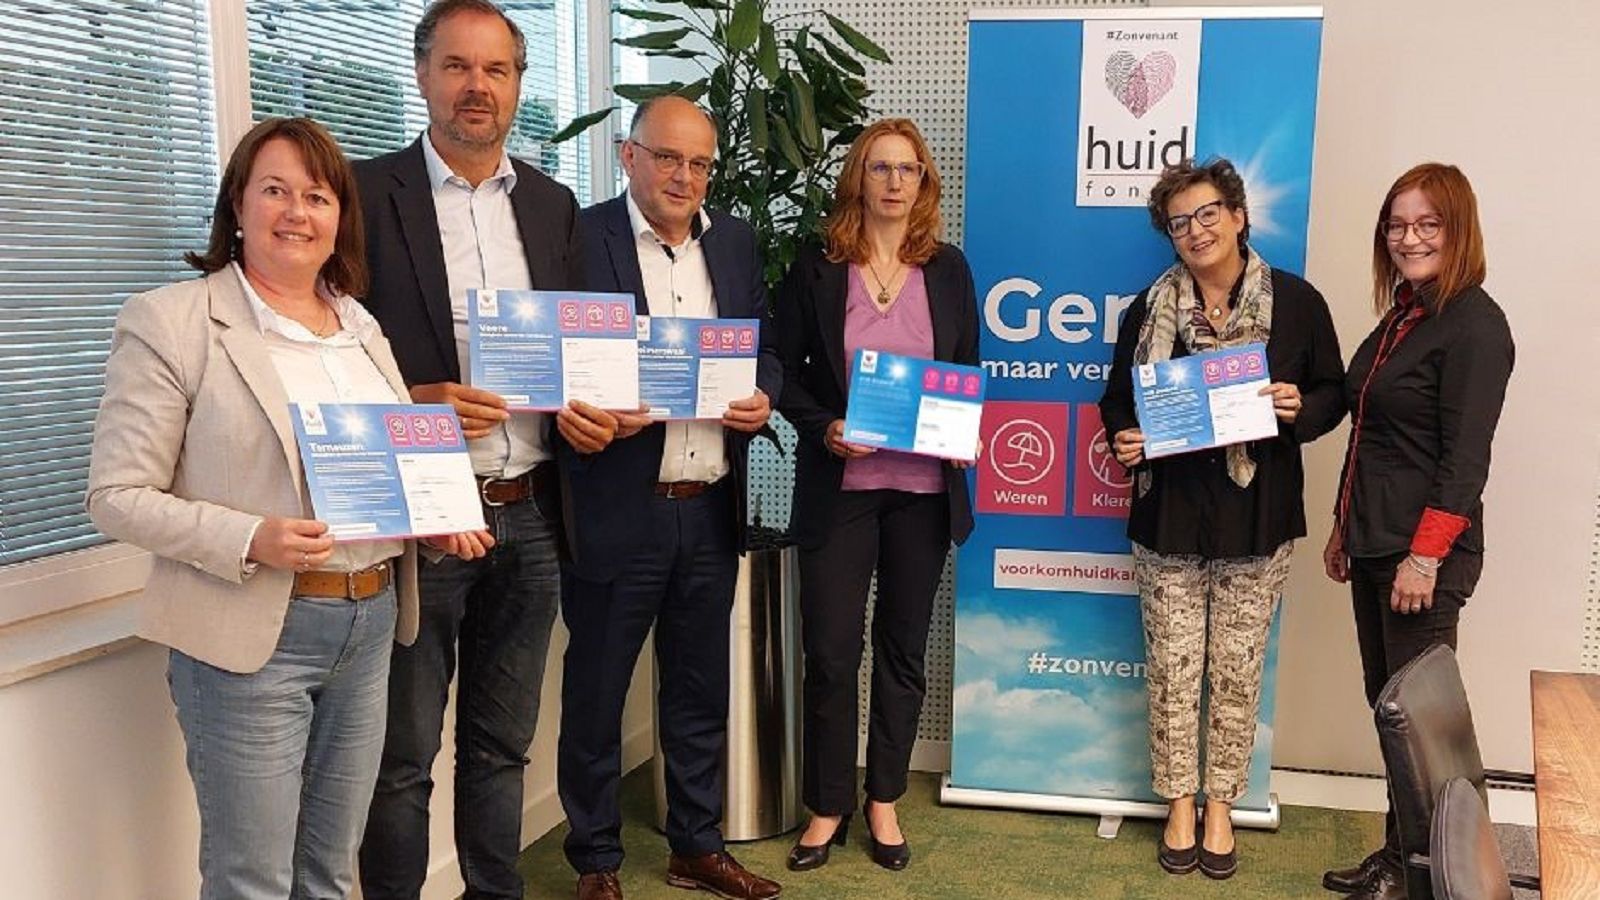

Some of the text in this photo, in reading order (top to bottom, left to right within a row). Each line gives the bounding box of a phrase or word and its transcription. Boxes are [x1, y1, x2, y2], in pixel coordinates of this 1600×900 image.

[1087, 125, 1188, 170] huid
[981, 359, 1057, 379] maar
[994, 490, 1048, 506] Weren
[1028, 652, 1147, 678] #zonven
